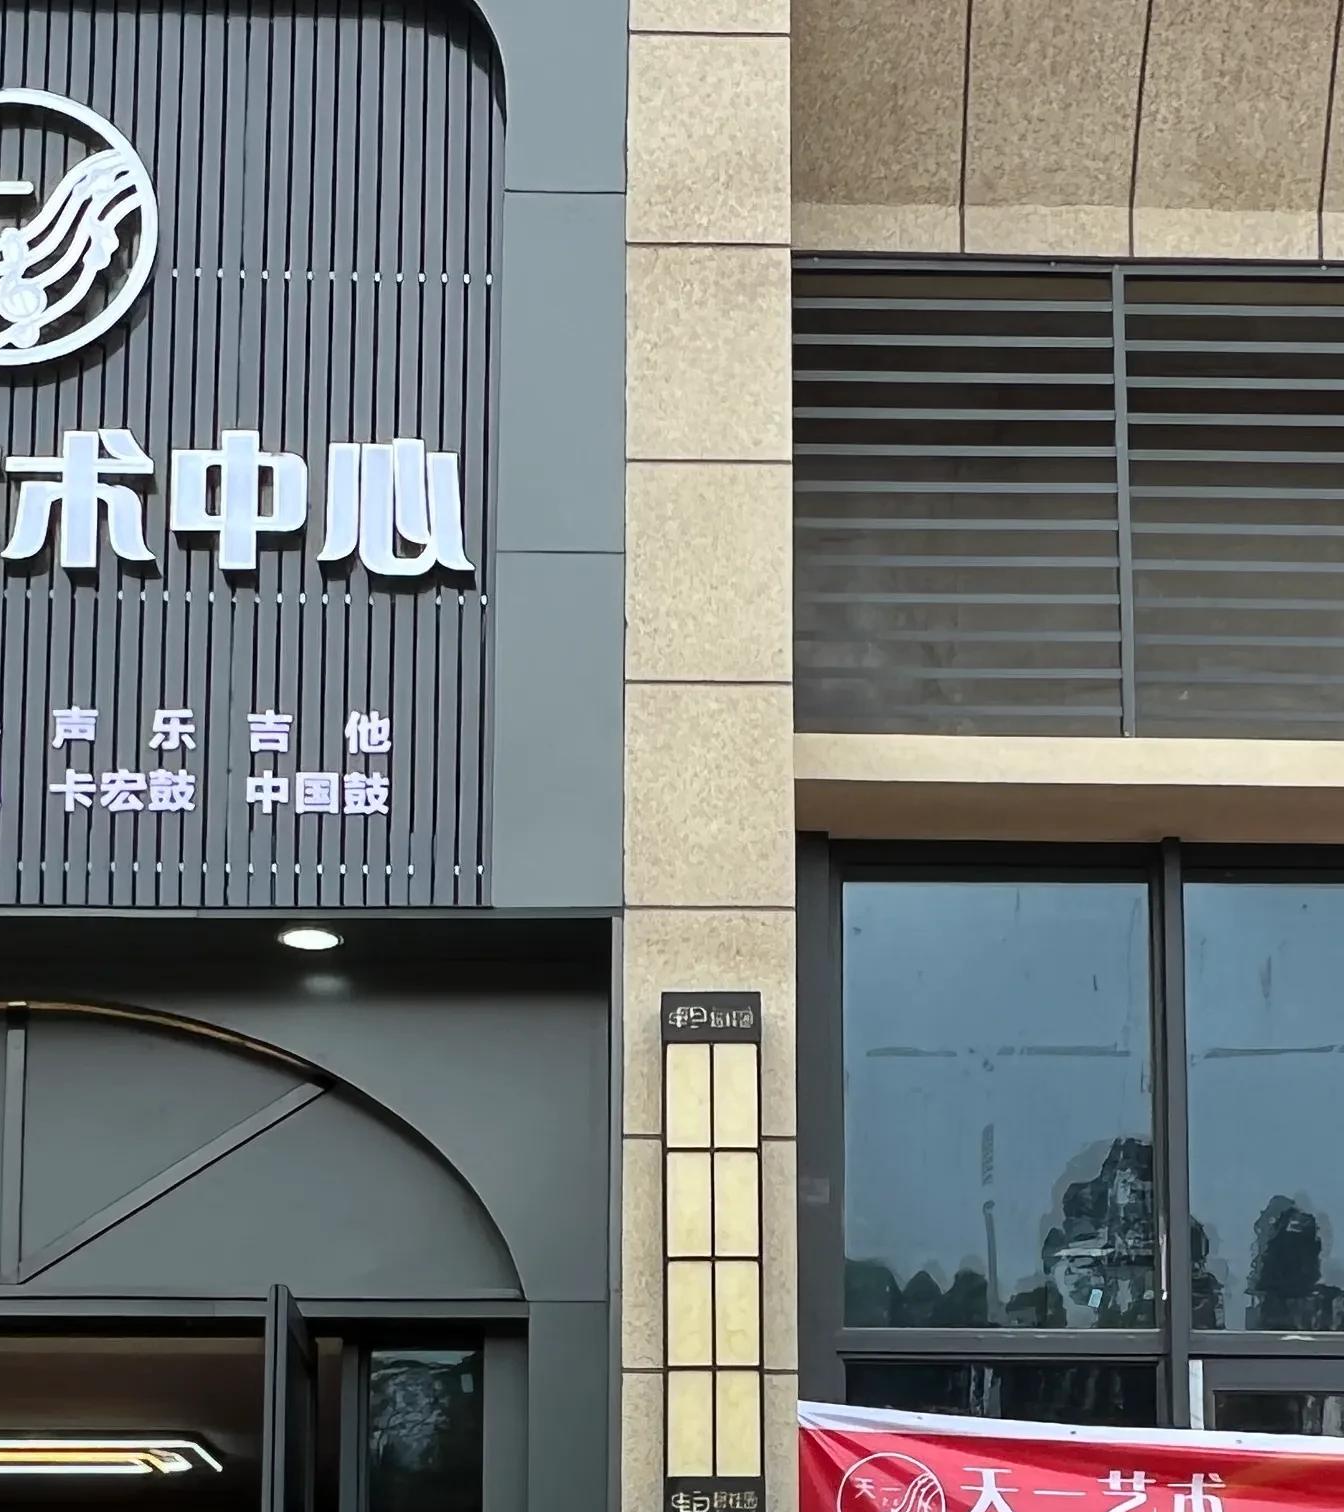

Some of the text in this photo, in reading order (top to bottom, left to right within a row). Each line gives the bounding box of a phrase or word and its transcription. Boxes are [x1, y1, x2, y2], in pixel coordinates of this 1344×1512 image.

[49, 768, 197, 813] 卡宏鼓
[246, 769, 391, 815] 中国鼓
